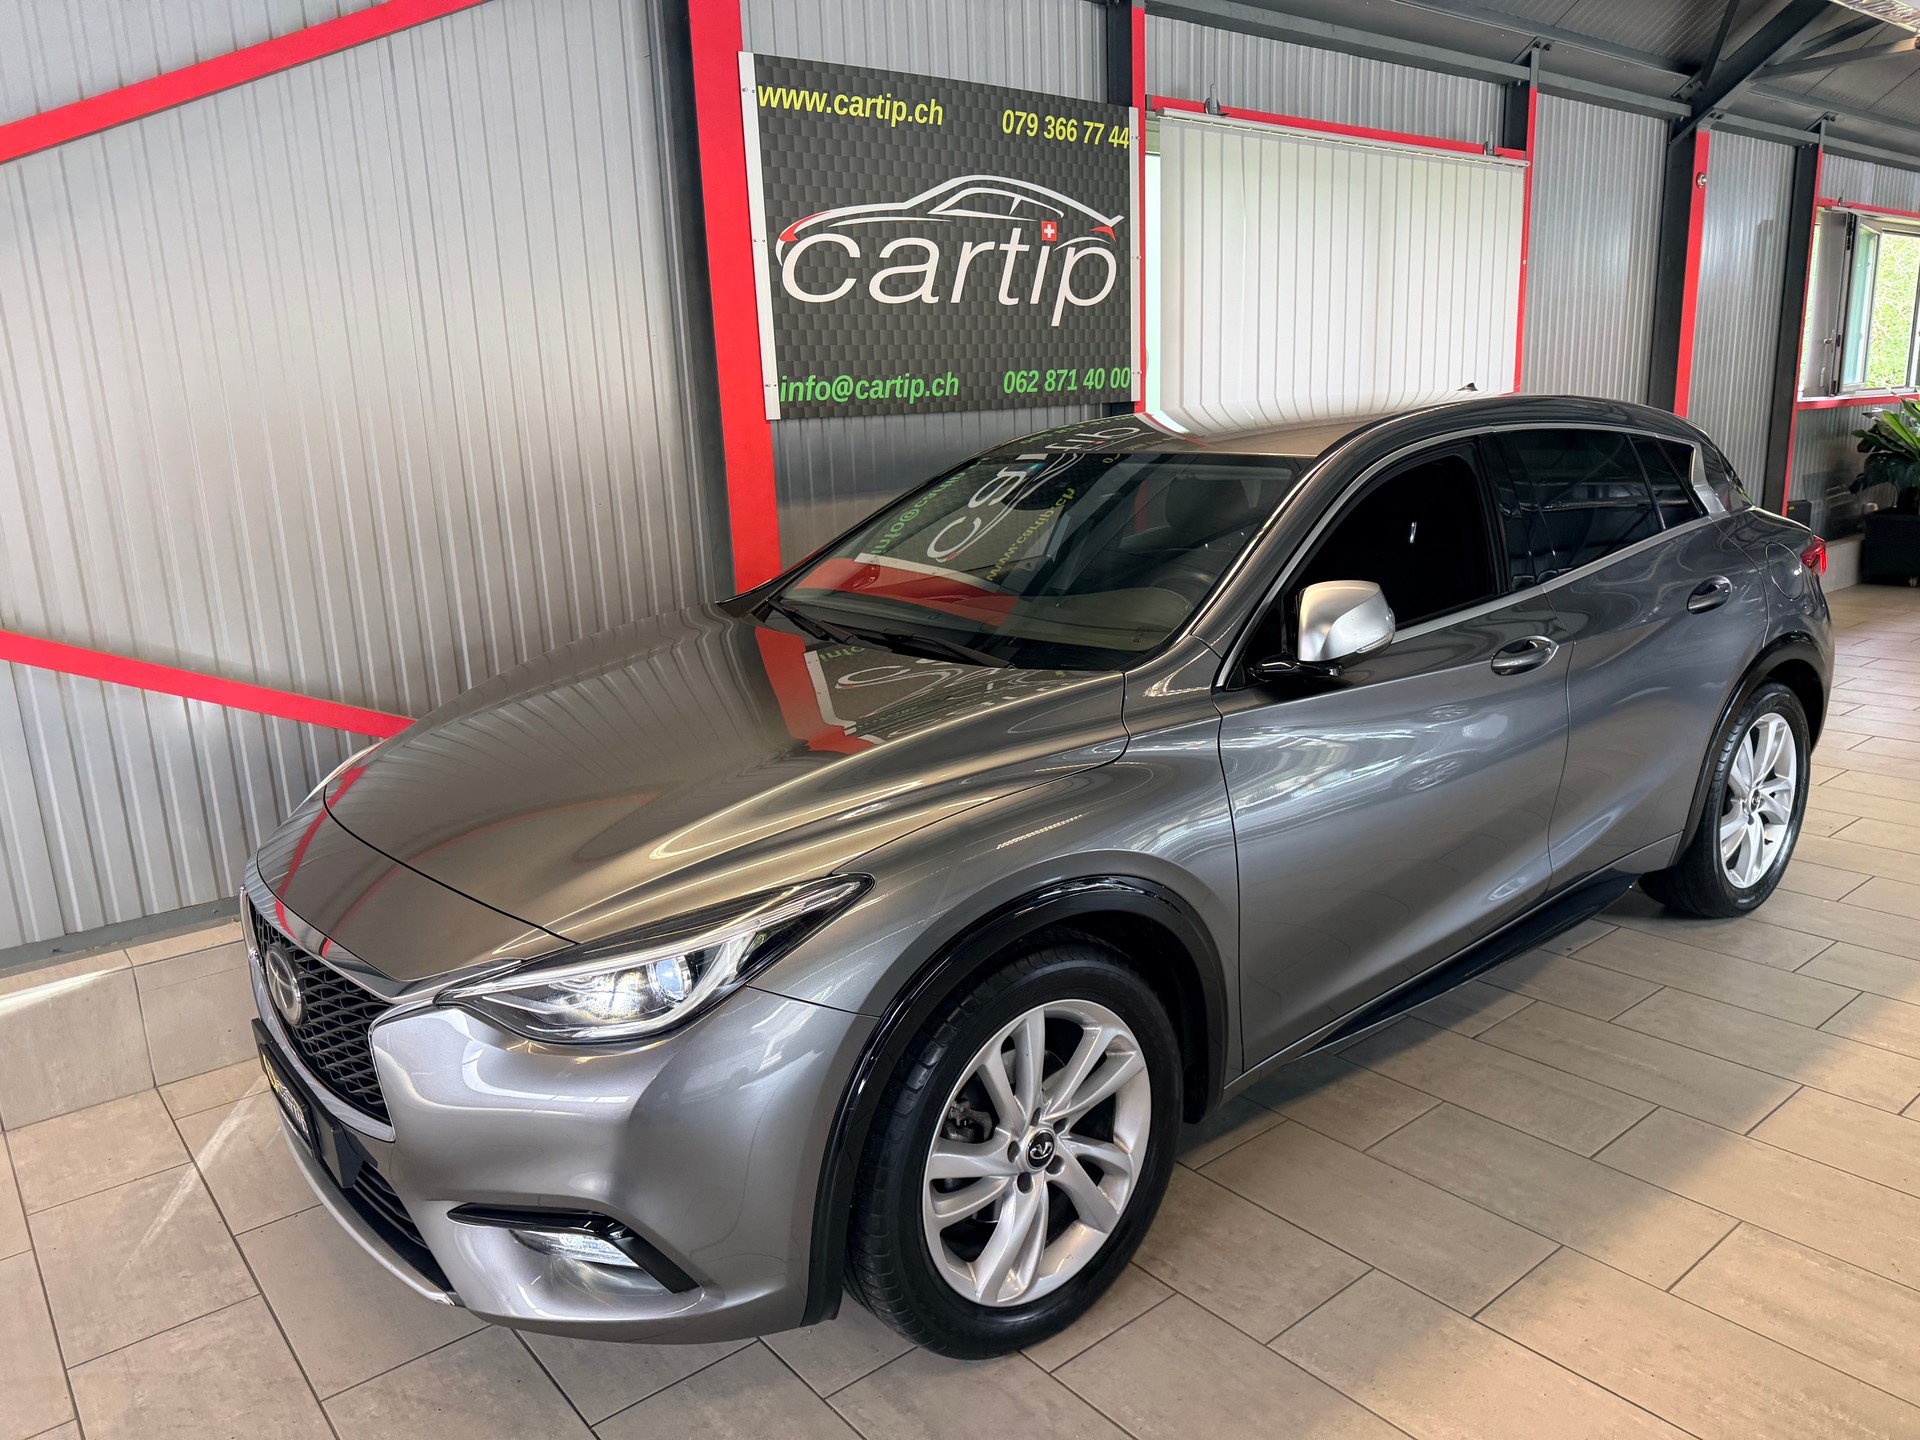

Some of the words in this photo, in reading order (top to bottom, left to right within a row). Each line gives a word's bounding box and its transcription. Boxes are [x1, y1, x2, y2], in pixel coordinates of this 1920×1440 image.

[757, 85, 944, 127] www.cartip.ch
[1002, 109, 1039, 137] 079
[1043, 115, 1078, 142] 366
[1082, 121, 1105, 145] 77
[1108, 126, 1130, 149] 44
[781, 221, 1118, 327] cartip
[779, 372, 959, 404] info@cartip.ch
[1003, 370, 1039, 394] 062
[1044, 369, 1078, 392] 871
[1082, 368, 1105, 390] 40
[1109, 367, 1131, 389] 00
